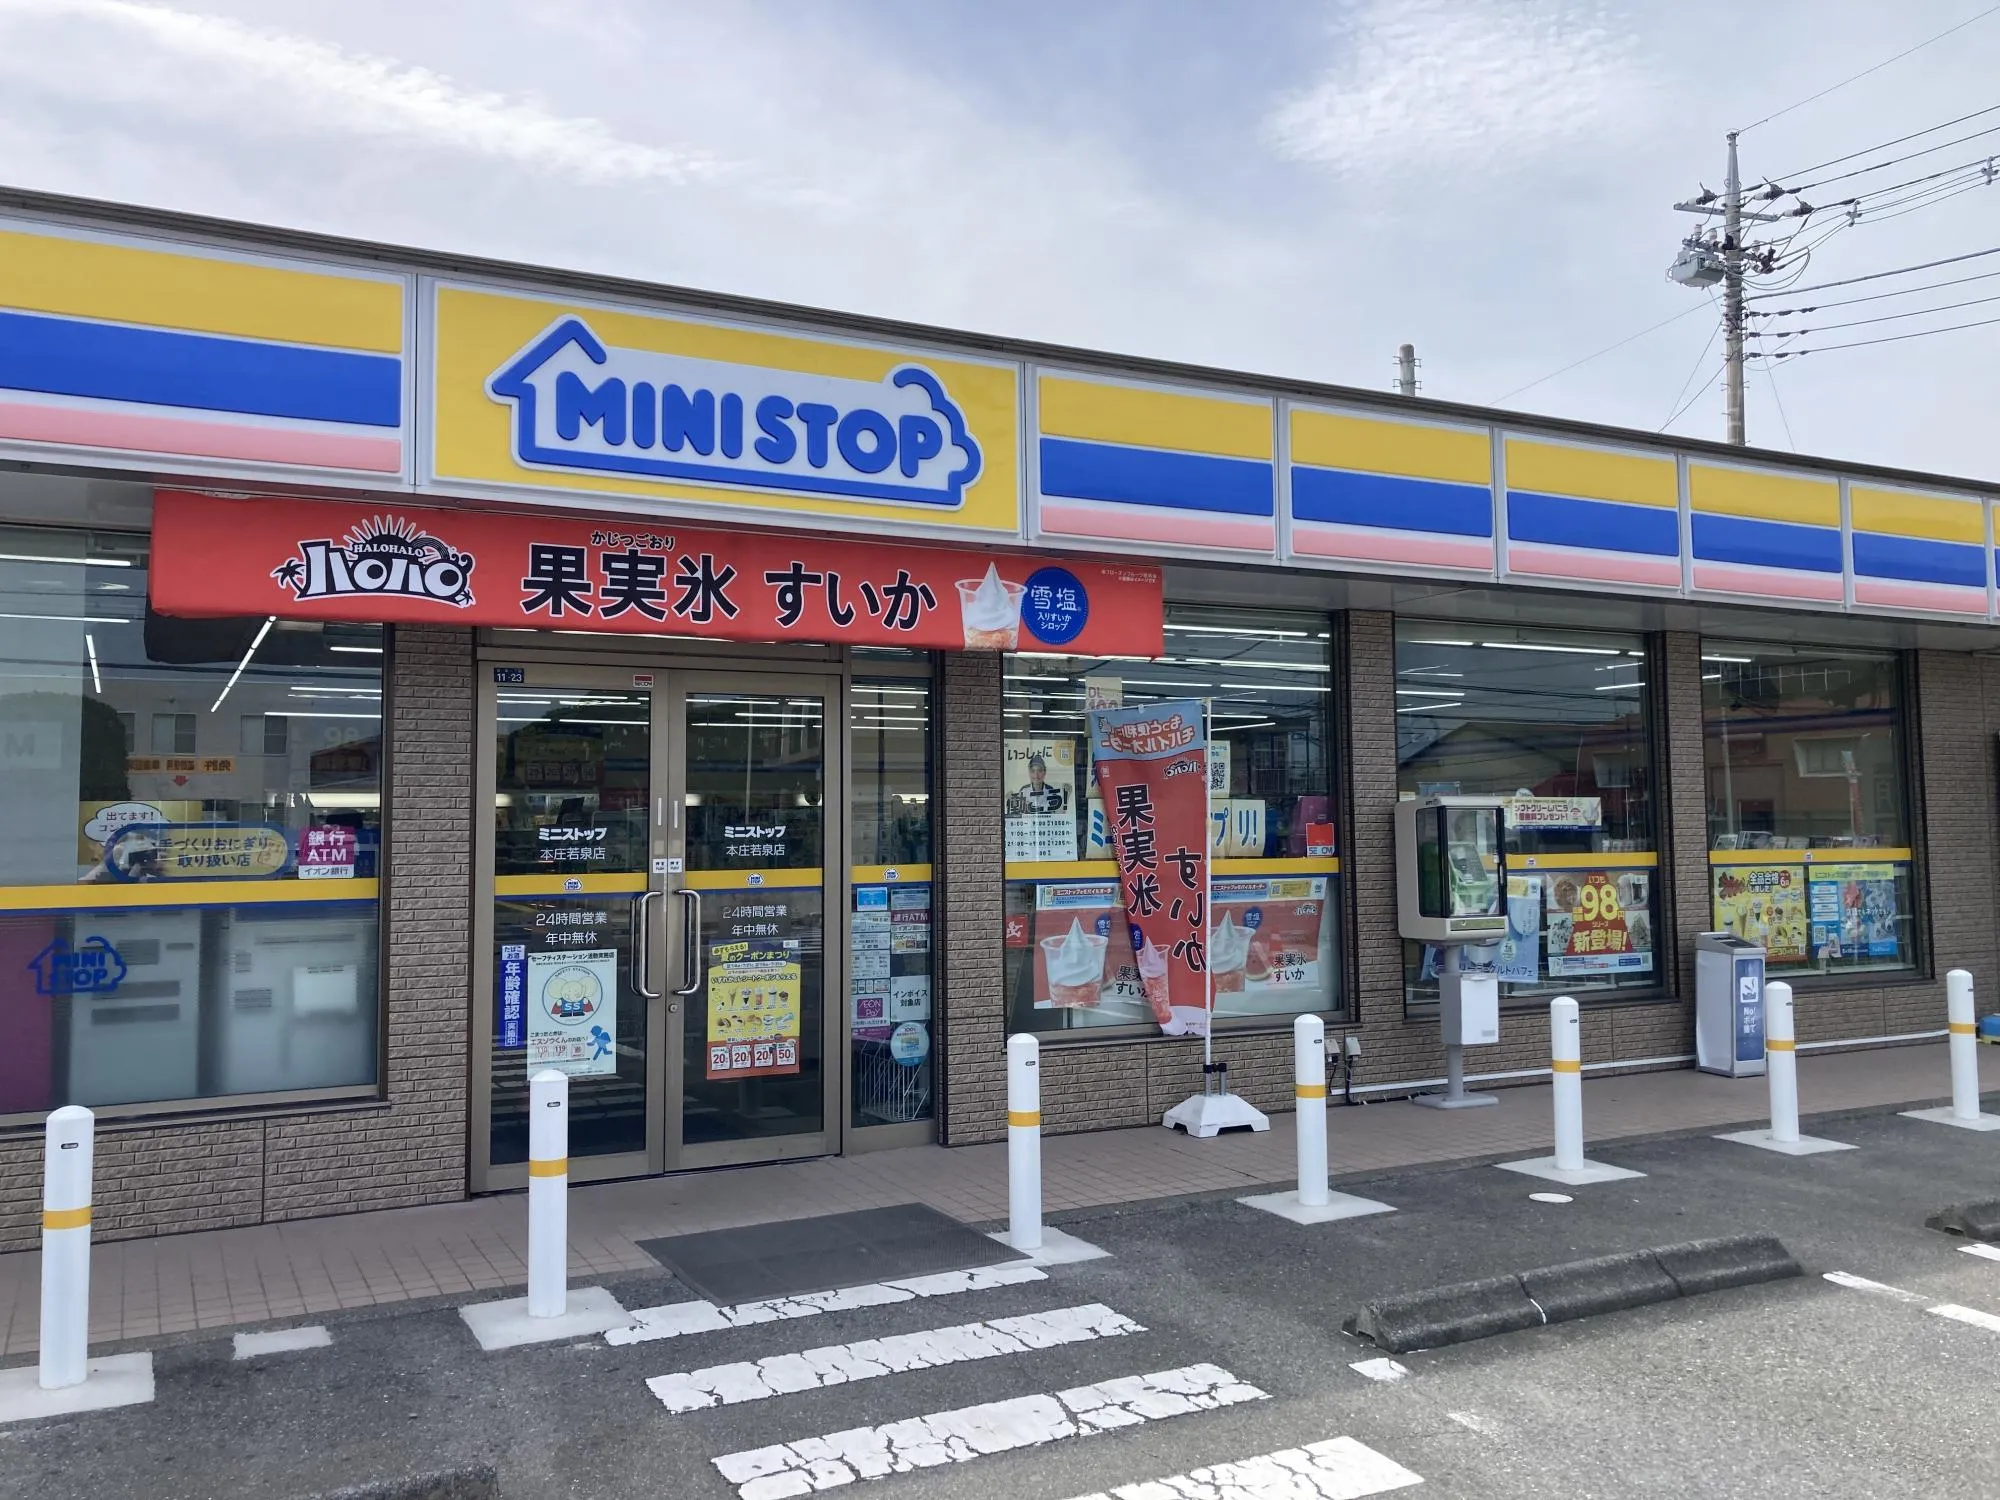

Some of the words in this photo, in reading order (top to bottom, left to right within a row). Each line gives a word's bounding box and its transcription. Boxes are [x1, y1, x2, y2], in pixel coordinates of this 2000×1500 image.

[591, 530, 676, 551] かじつごおり
[353, 541, 424, 558] HALOHALO
[521, 542, 740, 624] 果実氷
[766, 561, 937, 632] すいか
[1037, 612, 1072, 623] 入りすいか
[1040, 622, 1069, 632] シロップ
[497, 673, 522, 683] 11-23
[1008, 746, 1052, 760] いっしょに
[106, 811, 154, 821] 出てます!
[538, 827, 607, 841] ミニストップ
[724, 826, 786, 838] ミニストップ
[159, 837, 268, 852] 手づくりおにぎり
[308, 831, 346, 847] 銀行
[540, 847, 606, 860] 本庄若泉店
[726, 844, 785, 856] 本庄若泉店
[177, 853, 251, 868] 取り扱い店
[308, 851, 347, 863] ATM
[304, 867, 349, 876] イオン銀行
[723, 905, 787, 918] 24時間営業
[536, 912, 607, 926] 24時間営業
[731, 923, 779, 936] 年中無休
[546, 932, 597, 945] 年中無休
[1573, 929, 1627, 953] 新登場!
[53, 952, 107, 968] MINI
[1274, 954, 1307, 967] 果実氷
[1274, 968, 1305, 982] すいか
[505, 962, 521, 1020] 年齢確認
[894, 989, 928, 999] インボイス
[564, 1002, 581, 1011] SS
[778, 1049, 791, 1059] 50
